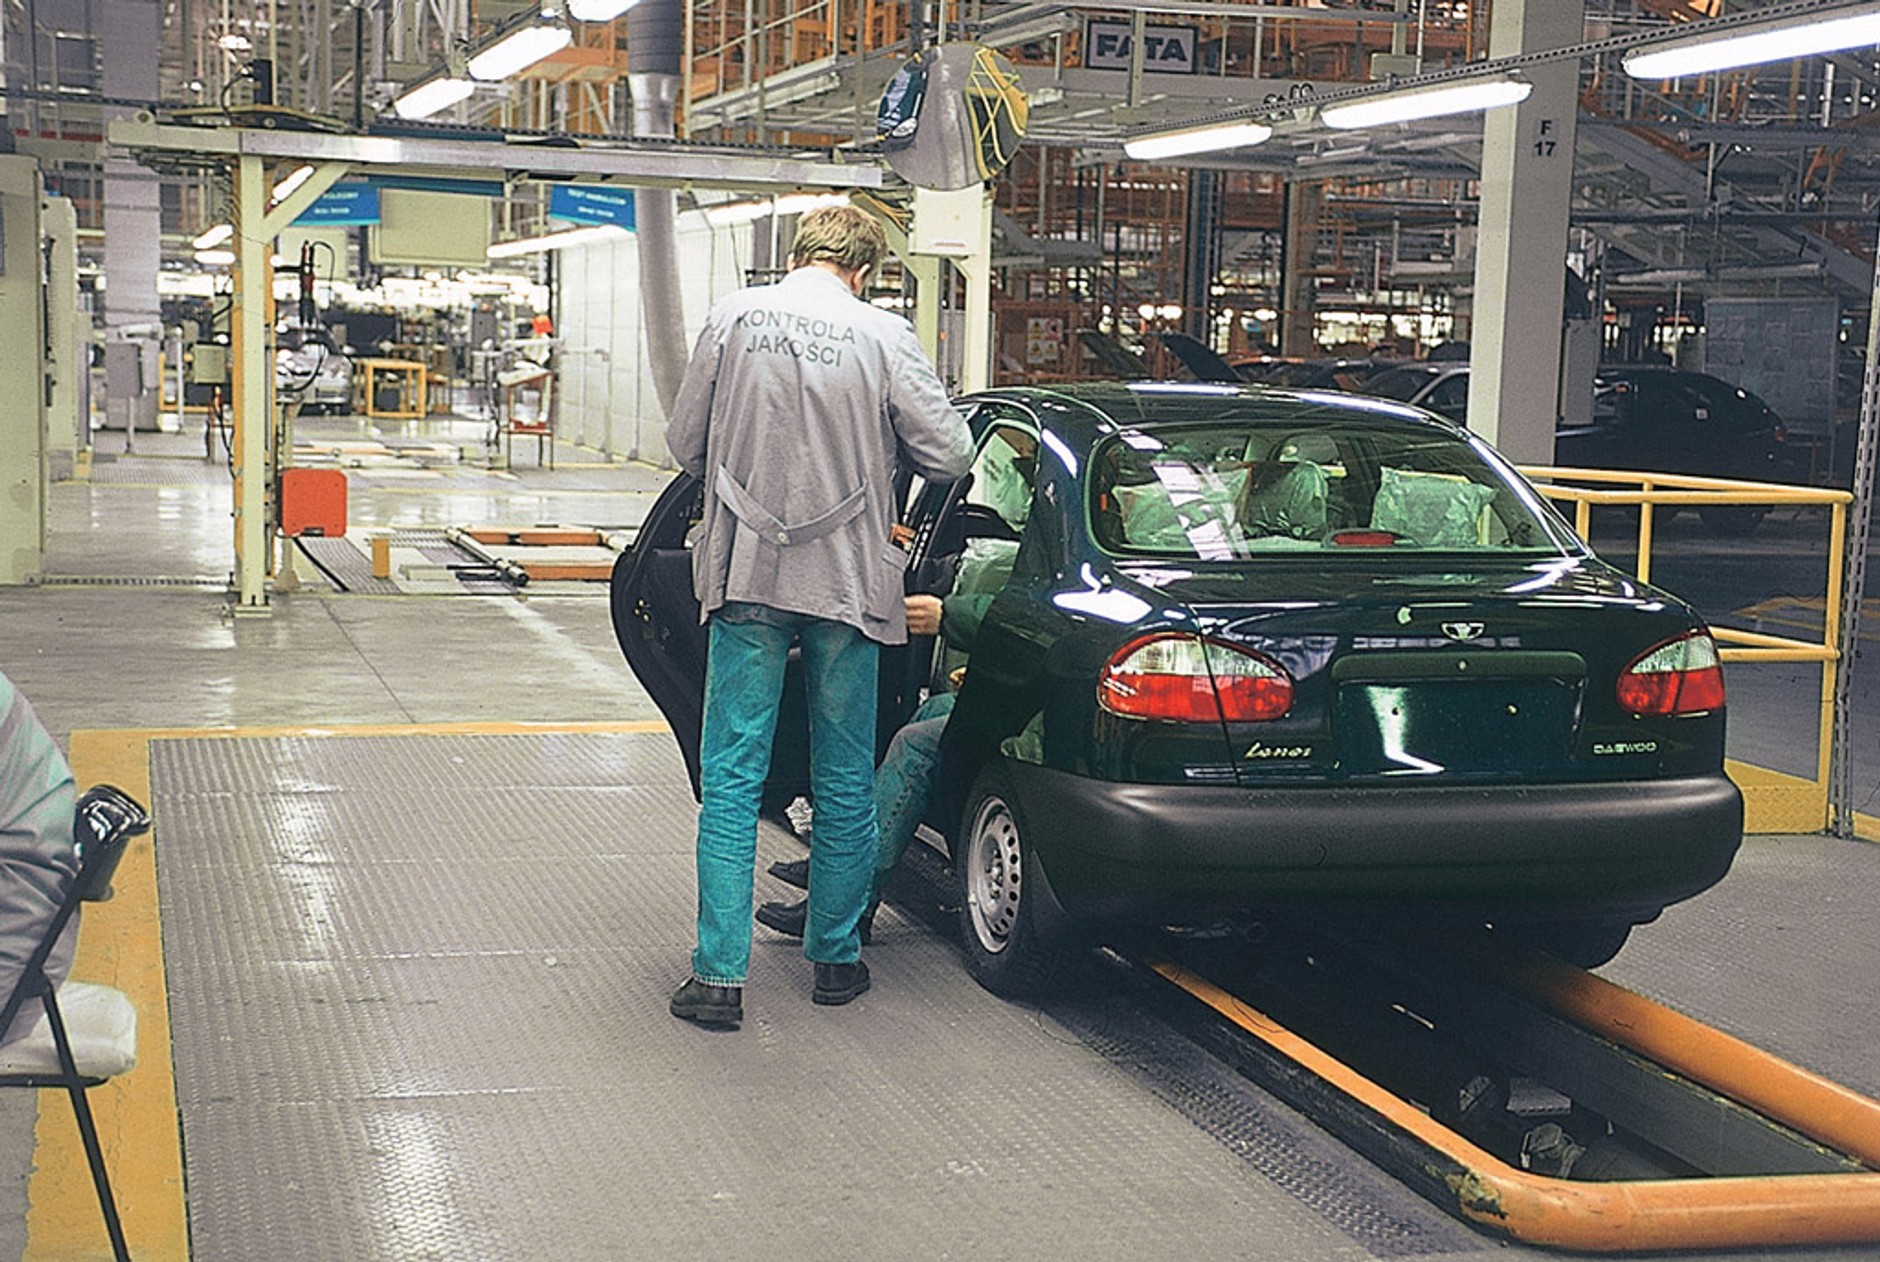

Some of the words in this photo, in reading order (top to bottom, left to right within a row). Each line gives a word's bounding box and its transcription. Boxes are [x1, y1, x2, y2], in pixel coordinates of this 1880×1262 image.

[1541, 120, 1552, 135] F
[1534, 141, 1556, 157] 17
[736, 309, 856, 344] KONTROLA
[746, 334, 842, 367] JAKOŚCI
[1593, 742, 1657, 754] DAEWOO
